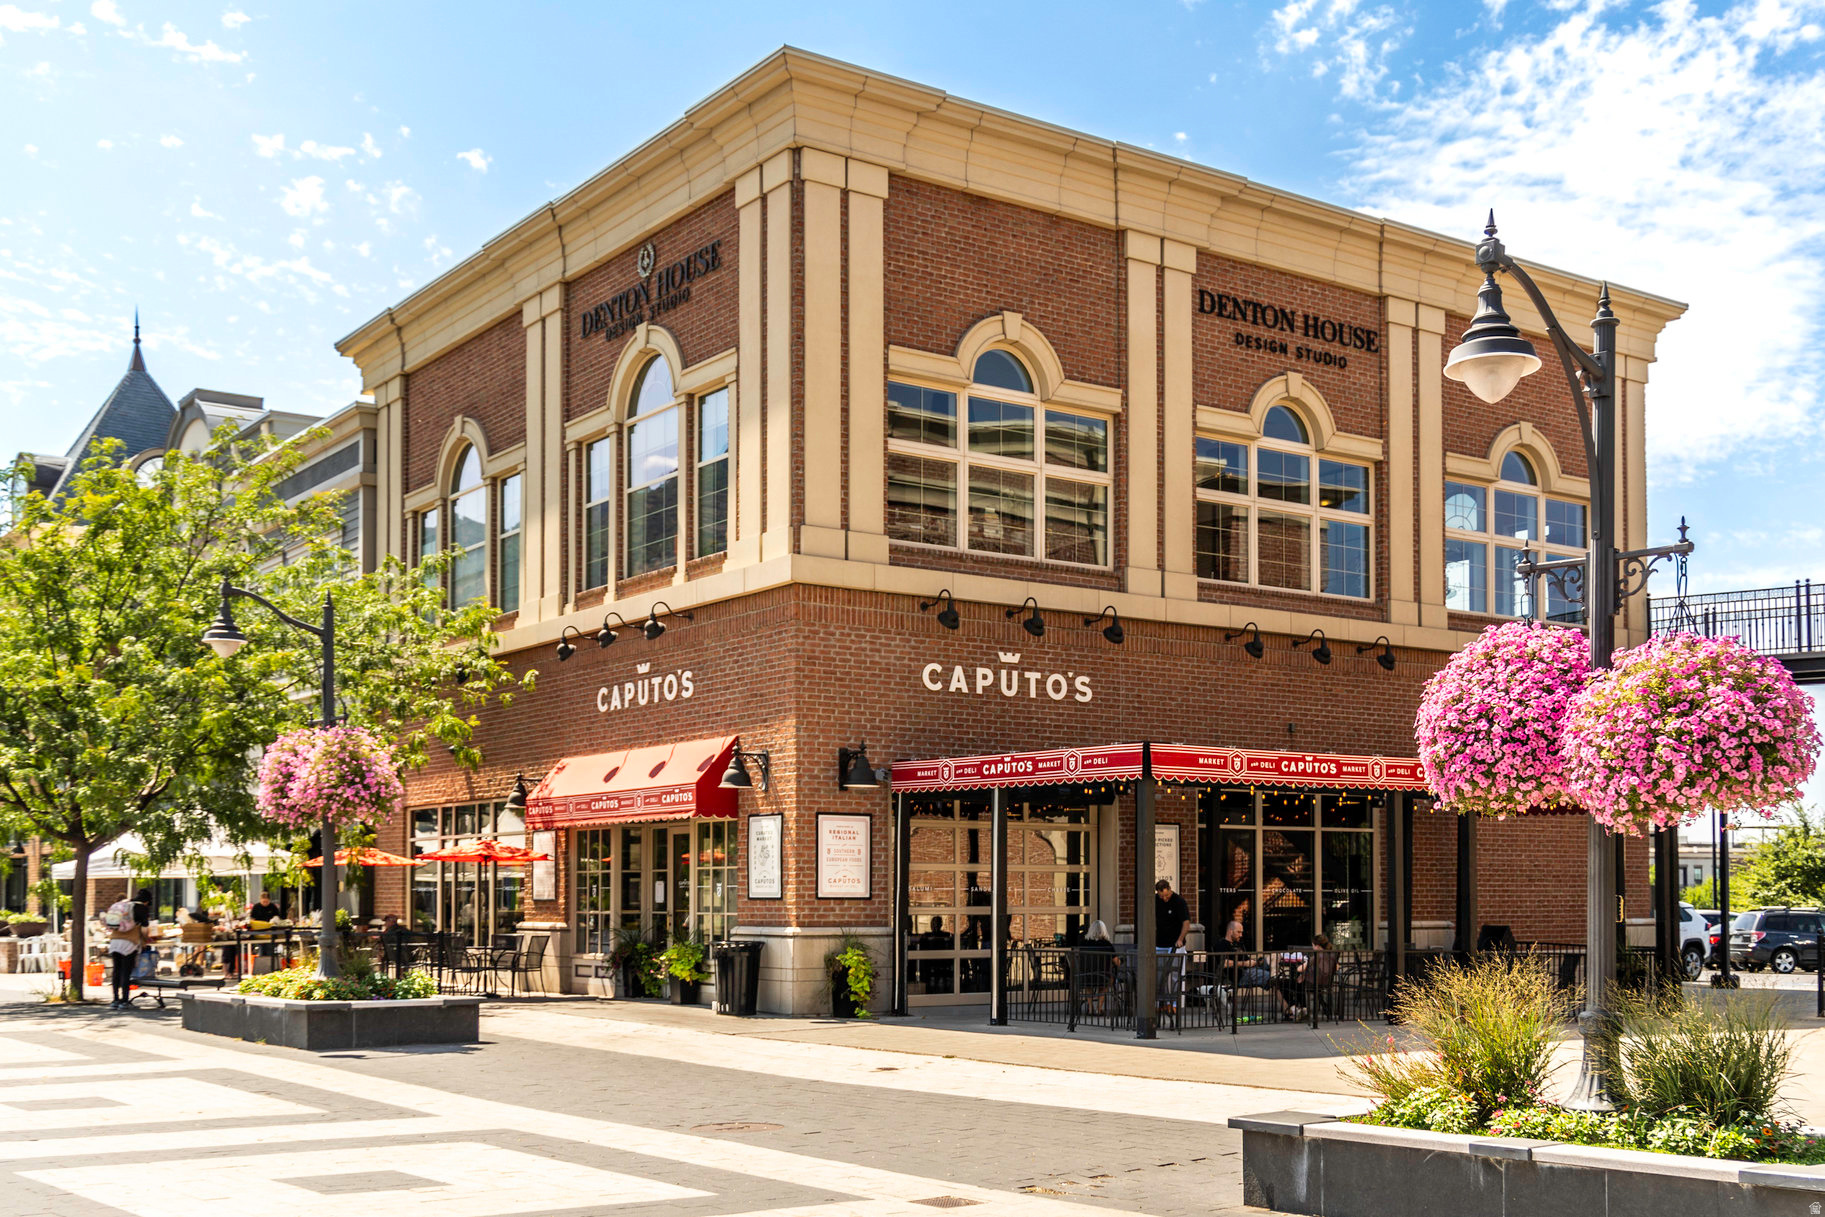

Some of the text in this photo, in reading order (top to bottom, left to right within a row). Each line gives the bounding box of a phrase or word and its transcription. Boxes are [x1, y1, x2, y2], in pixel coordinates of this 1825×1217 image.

[581, 240, 721, 339] DENTON HOUSE
[605, 286, 691, 342] DESIGN STUDIO
[1198, 289, 1380, 353] DENTON HOUSE
[1235, 332, 1348, 369] DESIGN STUDIO
[596, 669, 694, 713] CAPUTO'S
[922, 662, 1093, 703] CAPUTO'S
[917, 769, 937, 777] MARKET
[963, 767, 977, 775] DELI
[982, 760, 1033, 776] CAPUTO'S
[1038, 760, 1061, 769] MARKET
[1093, 757, 1108, 765] DELI
[1198, 757, 1224, 766] MARKET
[1260, 761, 1276, 769] DELI
[1281, 760, 1337, 775] CAPUTO'S
[1342, 765, 1366, 773] MARKET
[661, 791, 693, 803] CAPUTO'S
